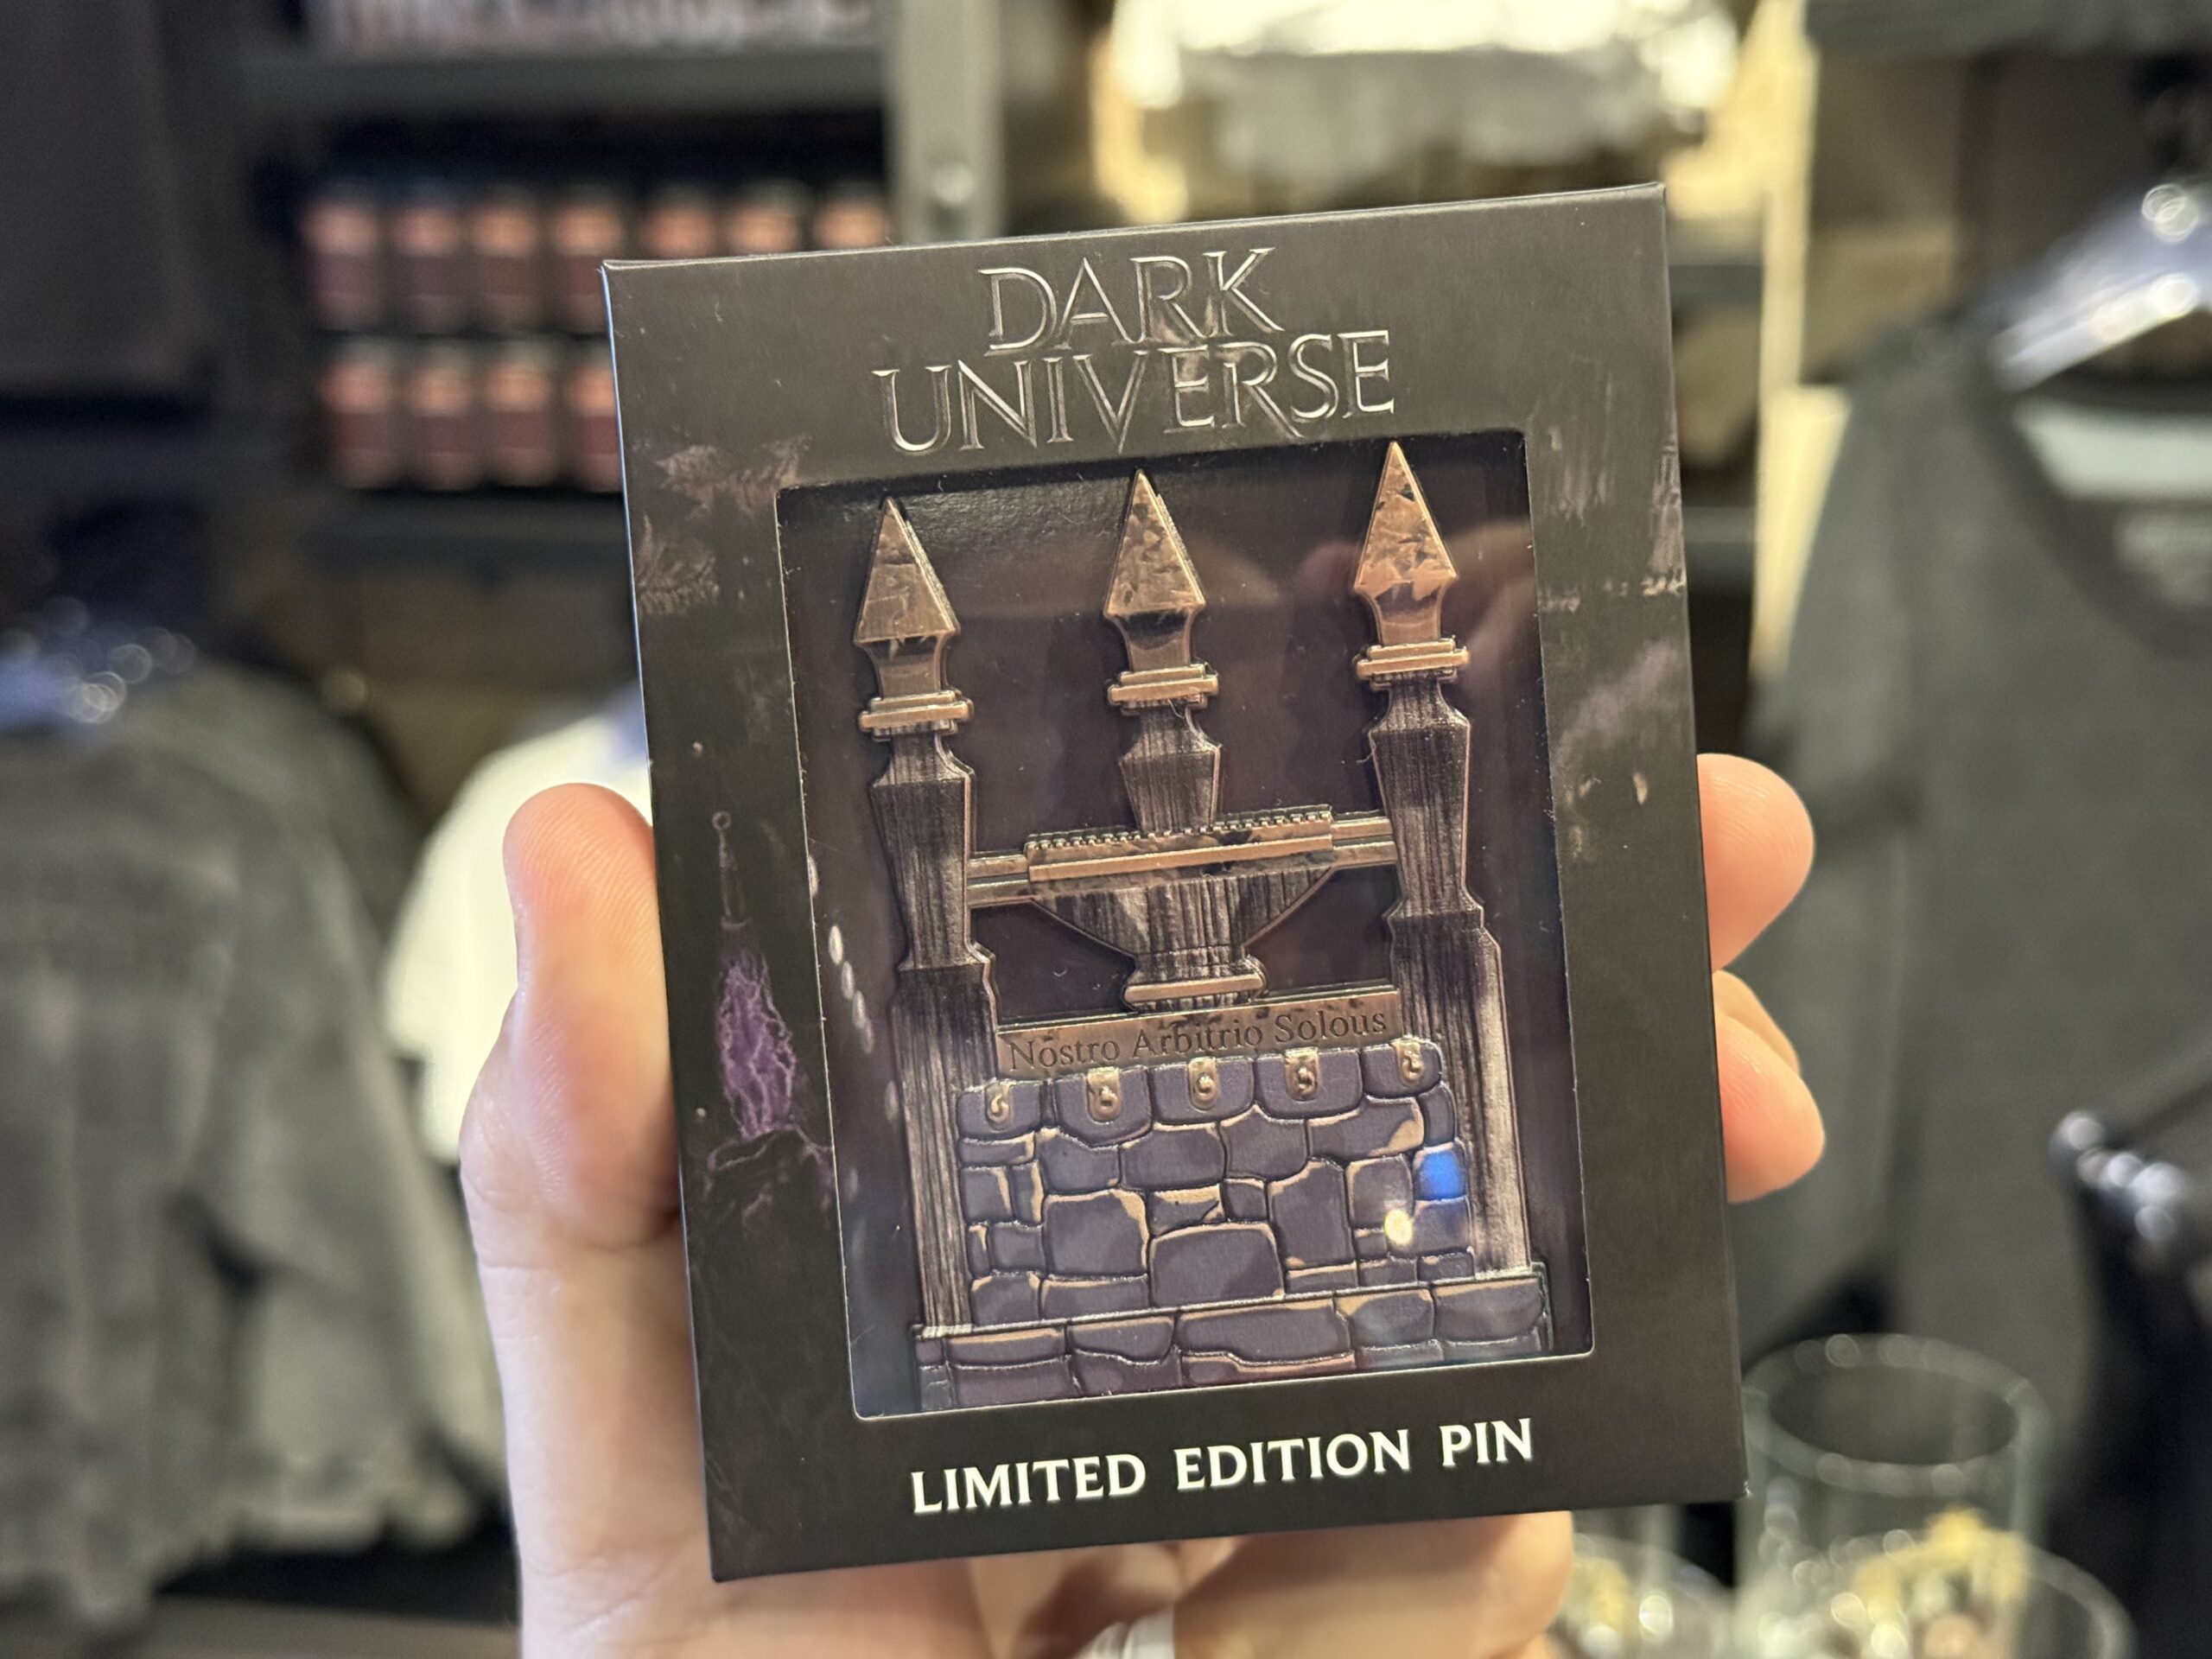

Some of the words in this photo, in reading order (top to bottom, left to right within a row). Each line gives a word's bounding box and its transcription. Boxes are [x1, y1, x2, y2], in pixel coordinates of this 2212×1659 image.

[978, 247, 1284, 357] DARK
[871, 330, 1395, 454] UNIVERSE
[1008, 1039, 1121, 1071] Nostro
[1133, 1020, 1263, 1057] Arbitrio
[1274, 1010, 1387, 1042] Solous
[910, 1452, 1147, 1514] LIMITED
[1173, 1428, 1411, 1491] EDITION
[1440, 1417, 1534, 1466] PIN
